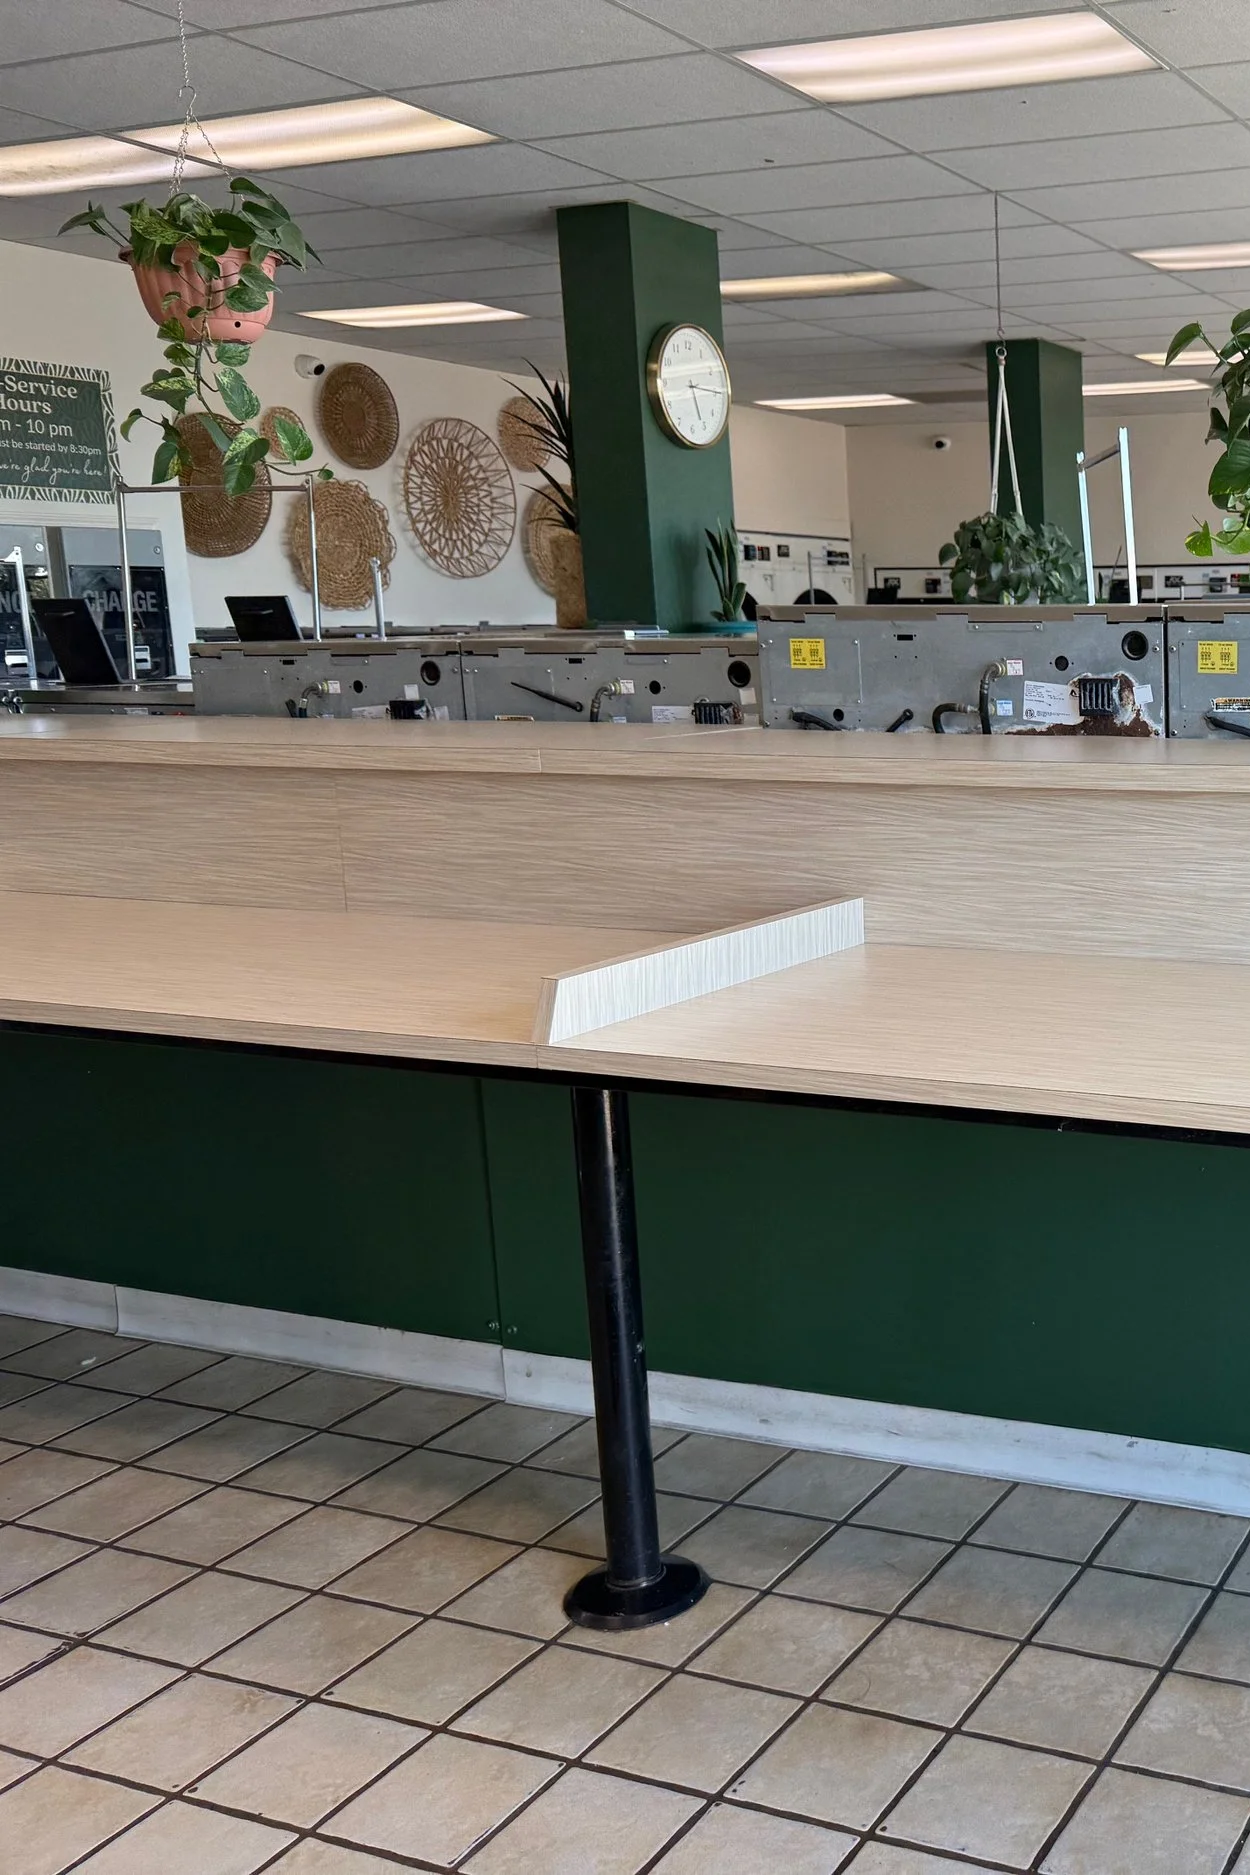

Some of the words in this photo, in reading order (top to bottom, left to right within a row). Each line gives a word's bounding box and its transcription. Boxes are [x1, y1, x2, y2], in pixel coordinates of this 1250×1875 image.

[672, 343, 680, 354] 11
[684, 340, 692, 351] 12
[699, 349, 703, 359] 1
[664, 357, 672, 367] 10
[708, 366, 713, 376] 2
[27, 419, 45, 434] 10
[49, 424, 73, 438] pm
[11, 440, 23, 449] be
[25, 442, 56, 452] started
[58, 444, 68, 454] by
[70, 444, 101, 456] 8:30pm
[21, 455, 50, 483] glad
[49, 463, 80, 485] you're
[83, 459, 107, 476] here!
